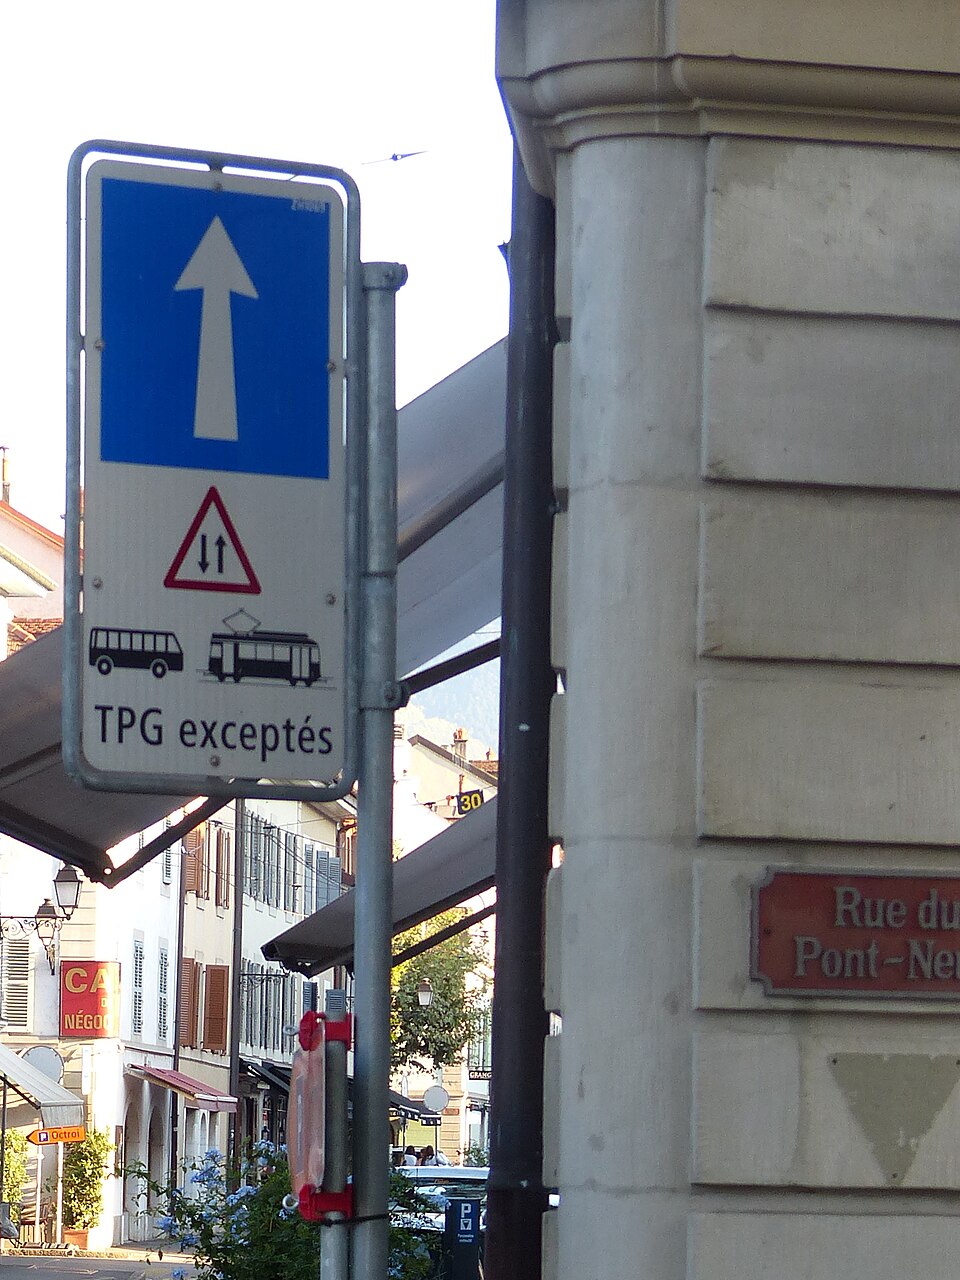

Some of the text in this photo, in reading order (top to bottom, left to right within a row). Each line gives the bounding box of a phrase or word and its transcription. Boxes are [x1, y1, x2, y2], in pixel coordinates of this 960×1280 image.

[94, 704, 334, 763] TPG exceptés
[460, 793, 482, 811] 30
[833, 886, 960, 931] Rue du
[794, 935, 960, 979] Pont-Ne
[51, 1129, 80, 1140] Octroi
[461, 1203, 472, 1218] P
